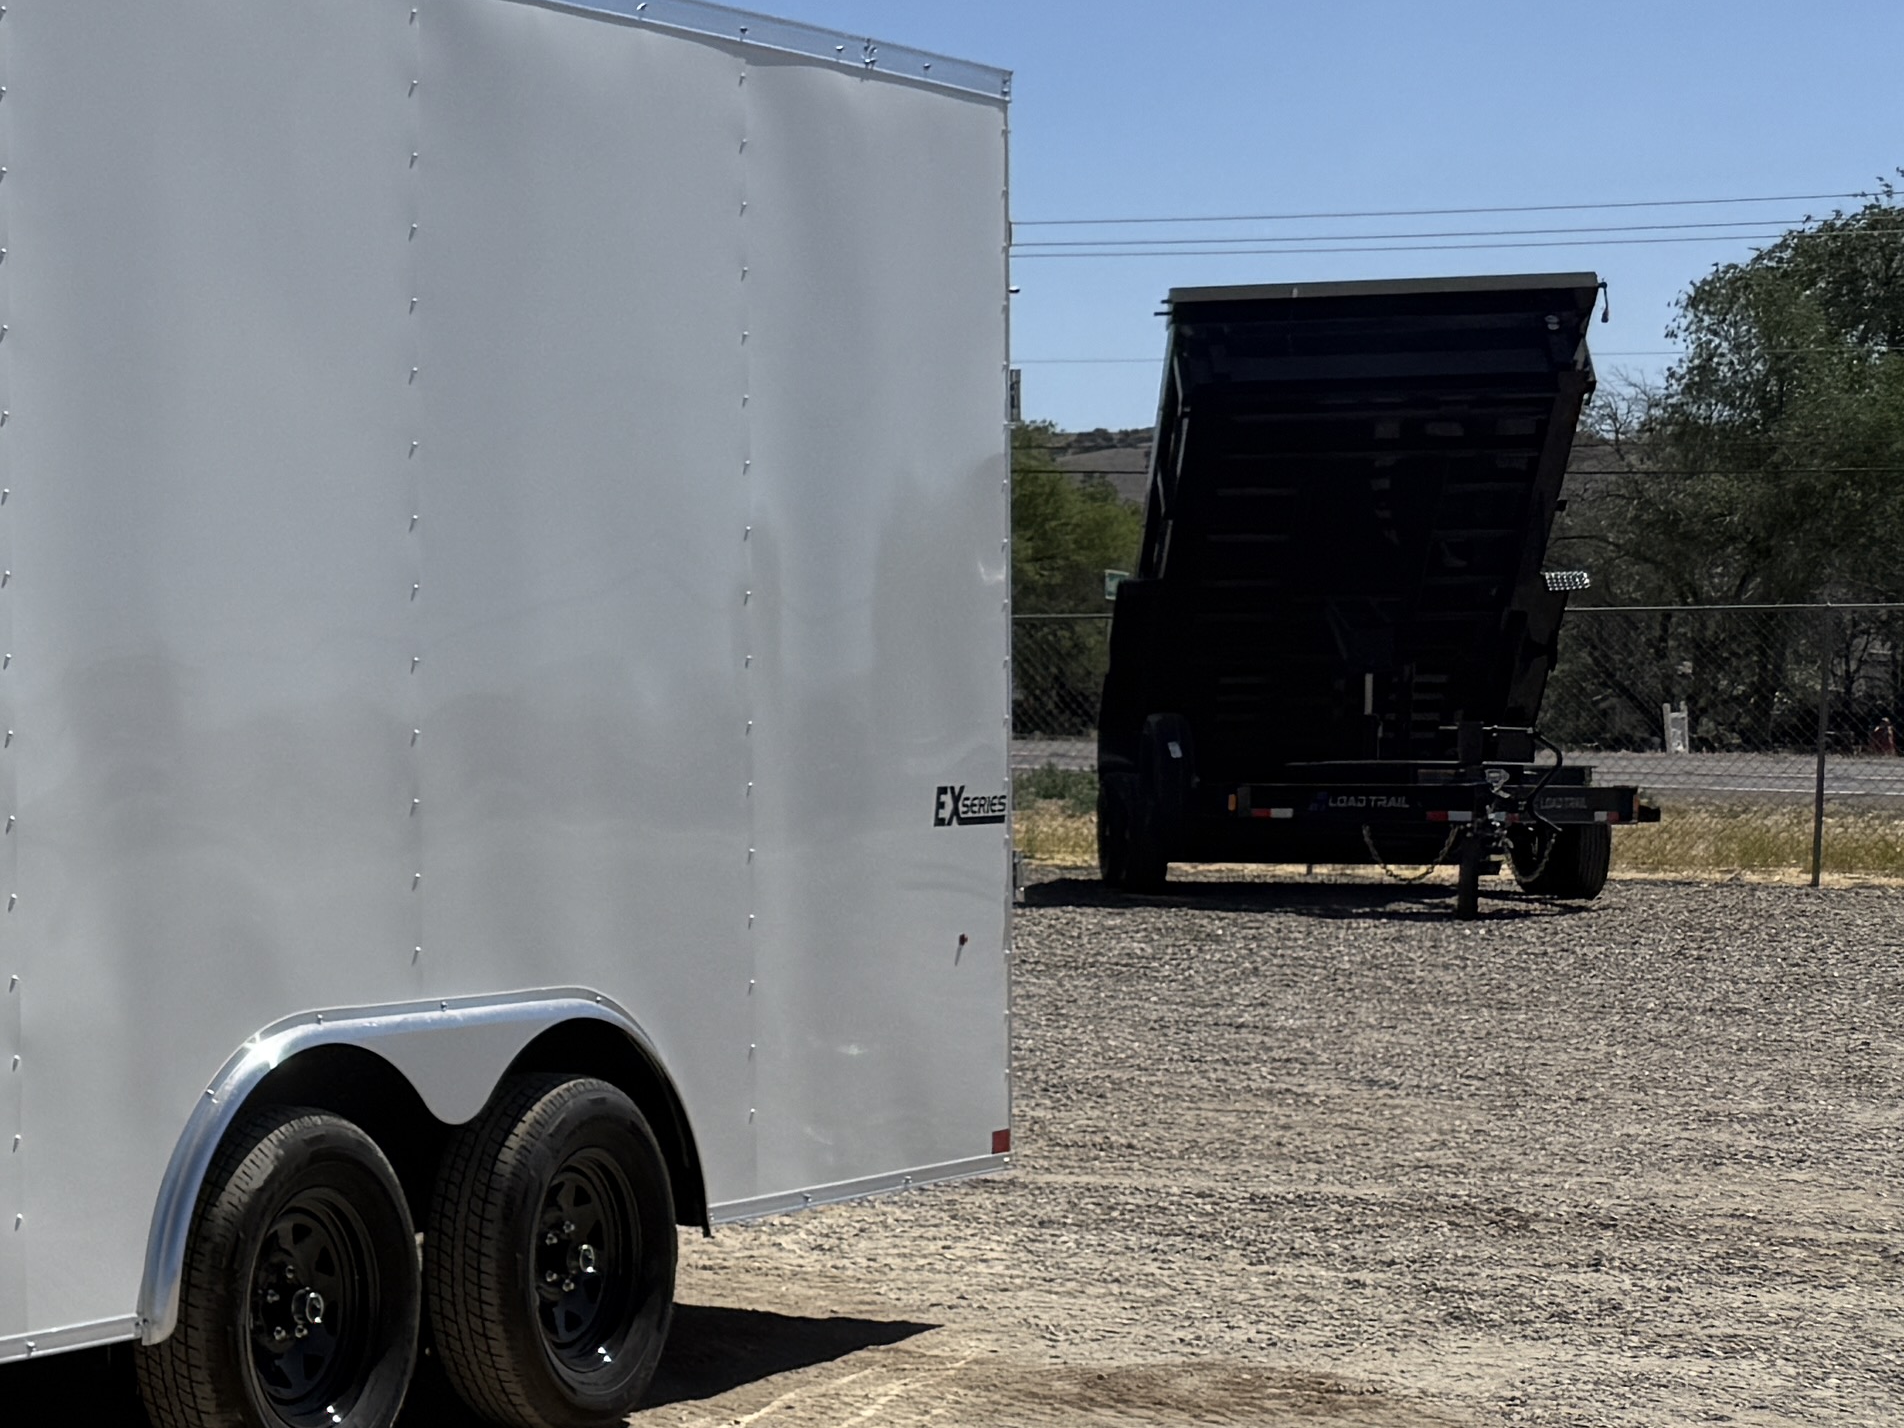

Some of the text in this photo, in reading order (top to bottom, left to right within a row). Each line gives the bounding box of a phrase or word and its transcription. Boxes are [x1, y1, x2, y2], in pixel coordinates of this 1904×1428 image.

[933, 784, 1007, 827] EX SERIES
[1328, 796, 1410, 808] LOAD TRAIL
